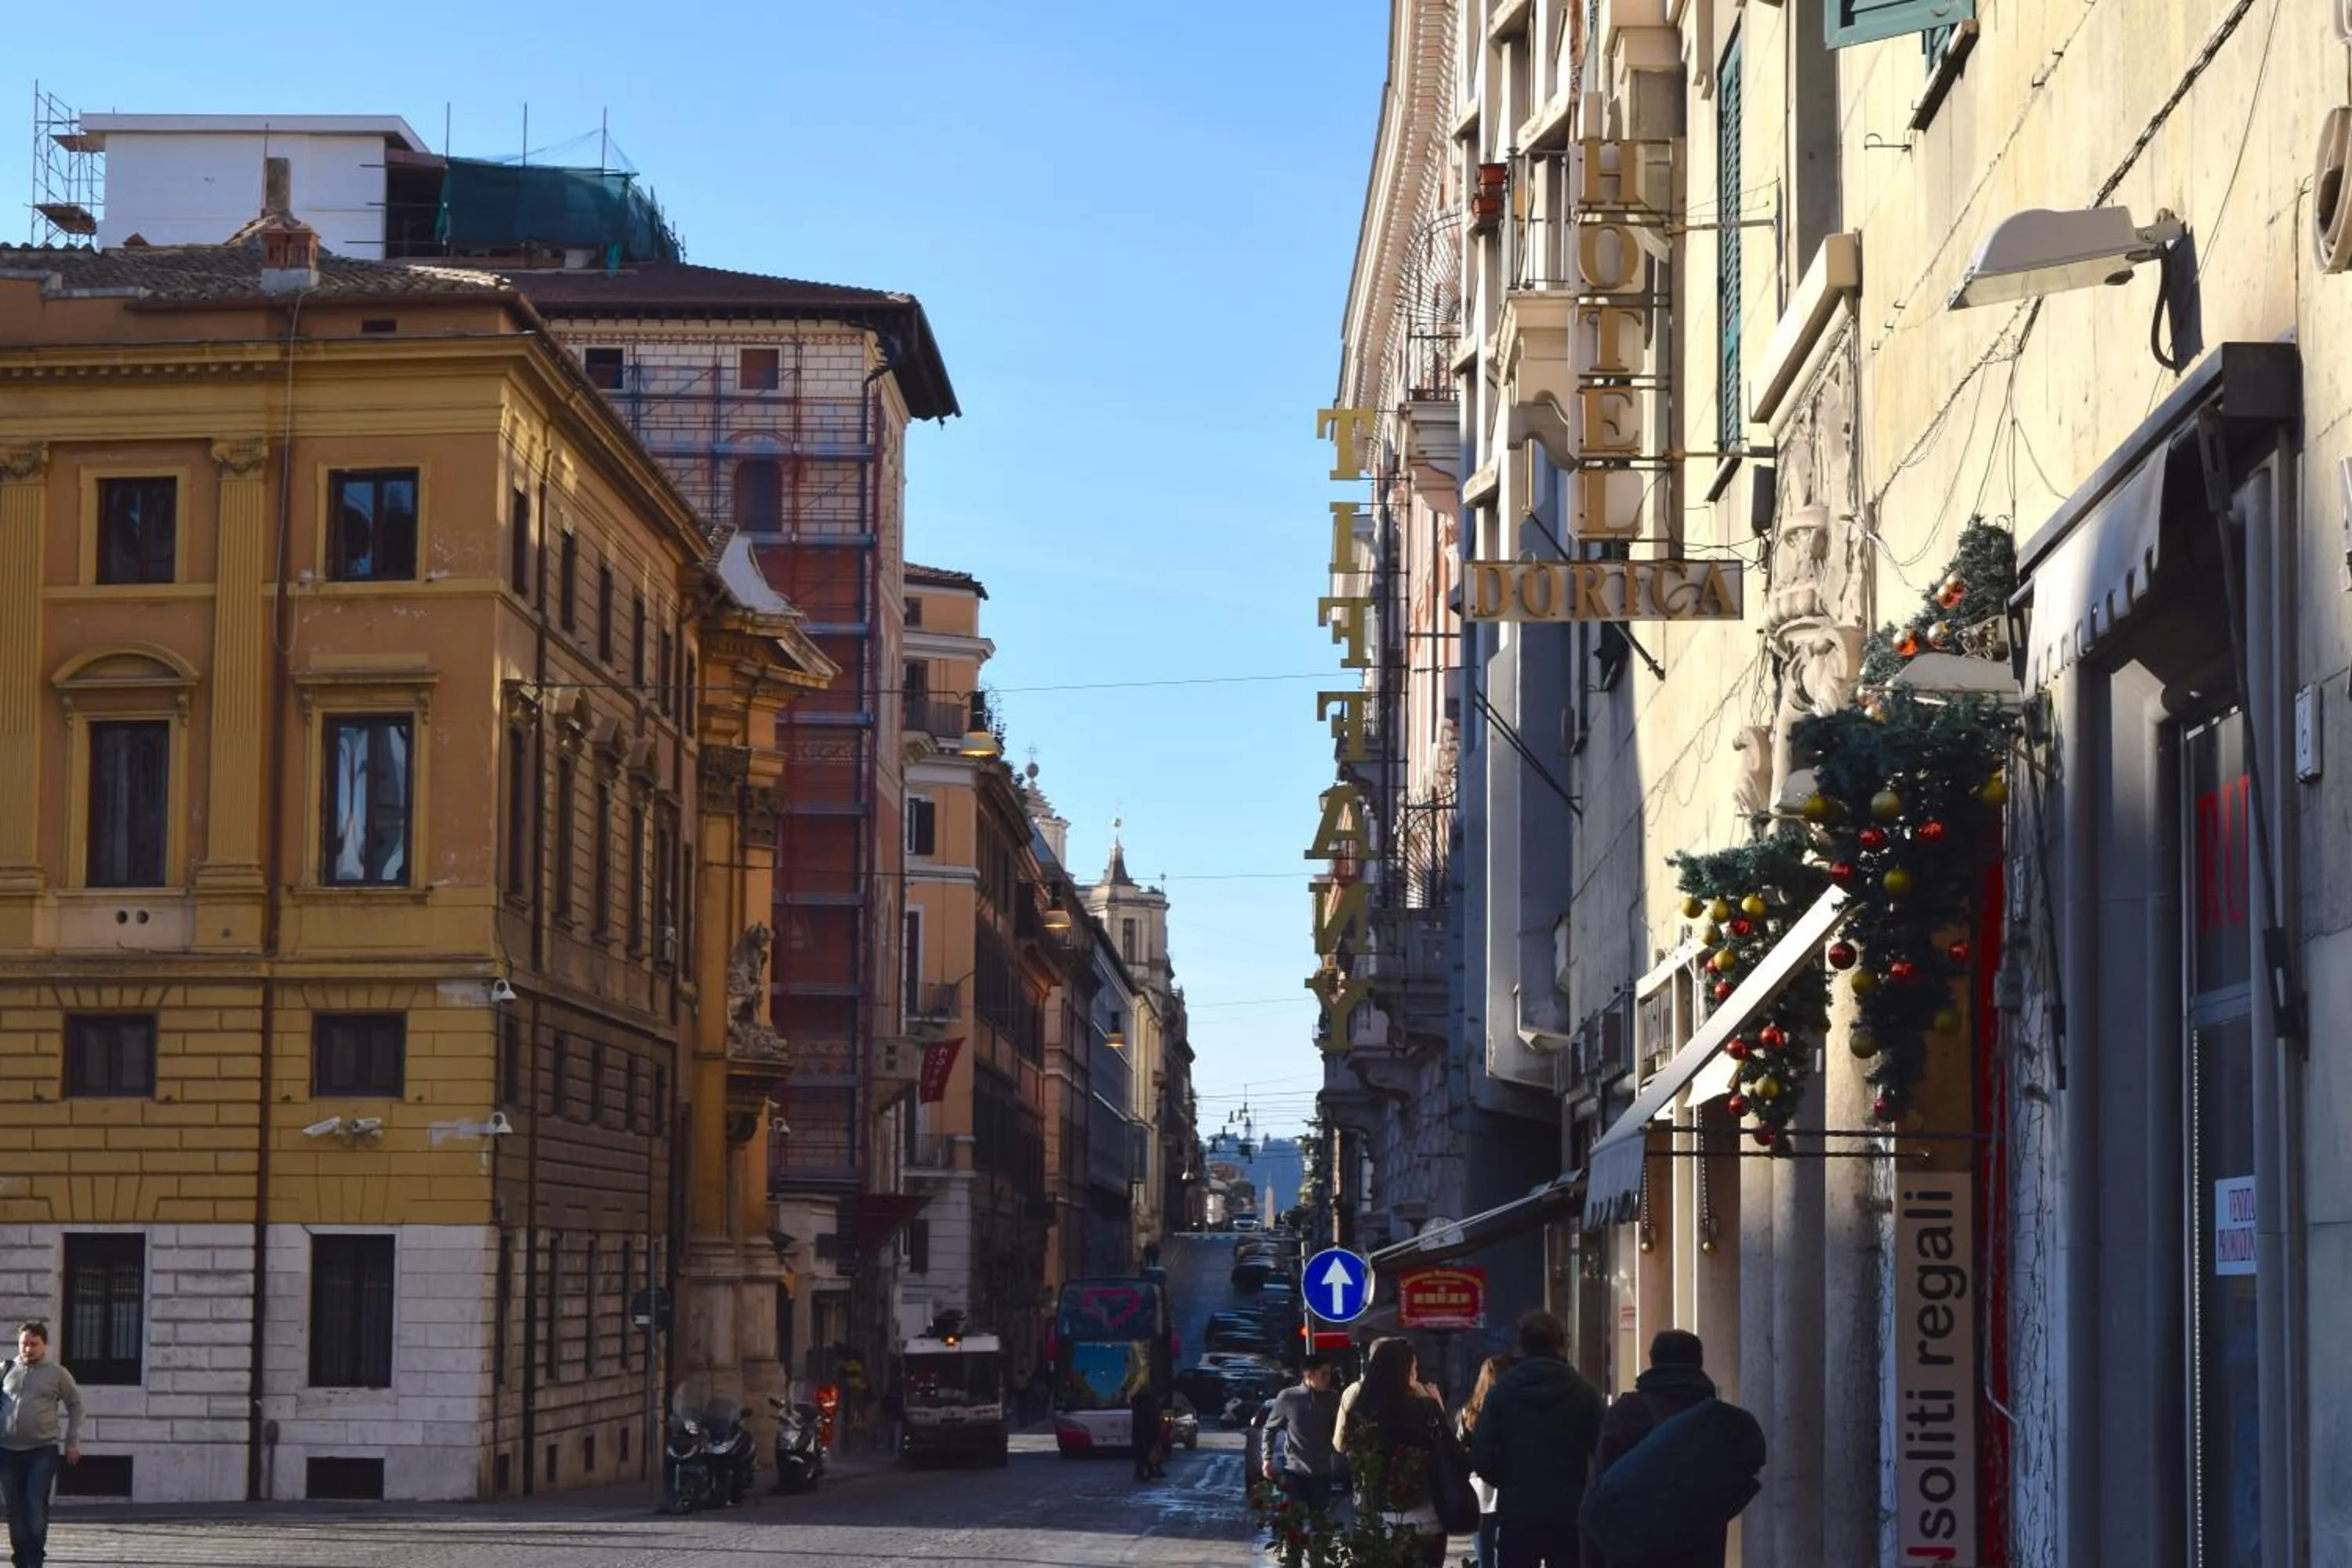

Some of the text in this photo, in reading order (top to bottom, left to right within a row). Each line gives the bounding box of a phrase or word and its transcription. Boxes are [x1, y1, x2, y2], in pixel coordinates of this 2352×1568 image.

[1577, 138, 1642, 538] HOTEL
[1474, 562, 1734, 618] DORICA
[1904, 1190, 1967, 1367] regali
